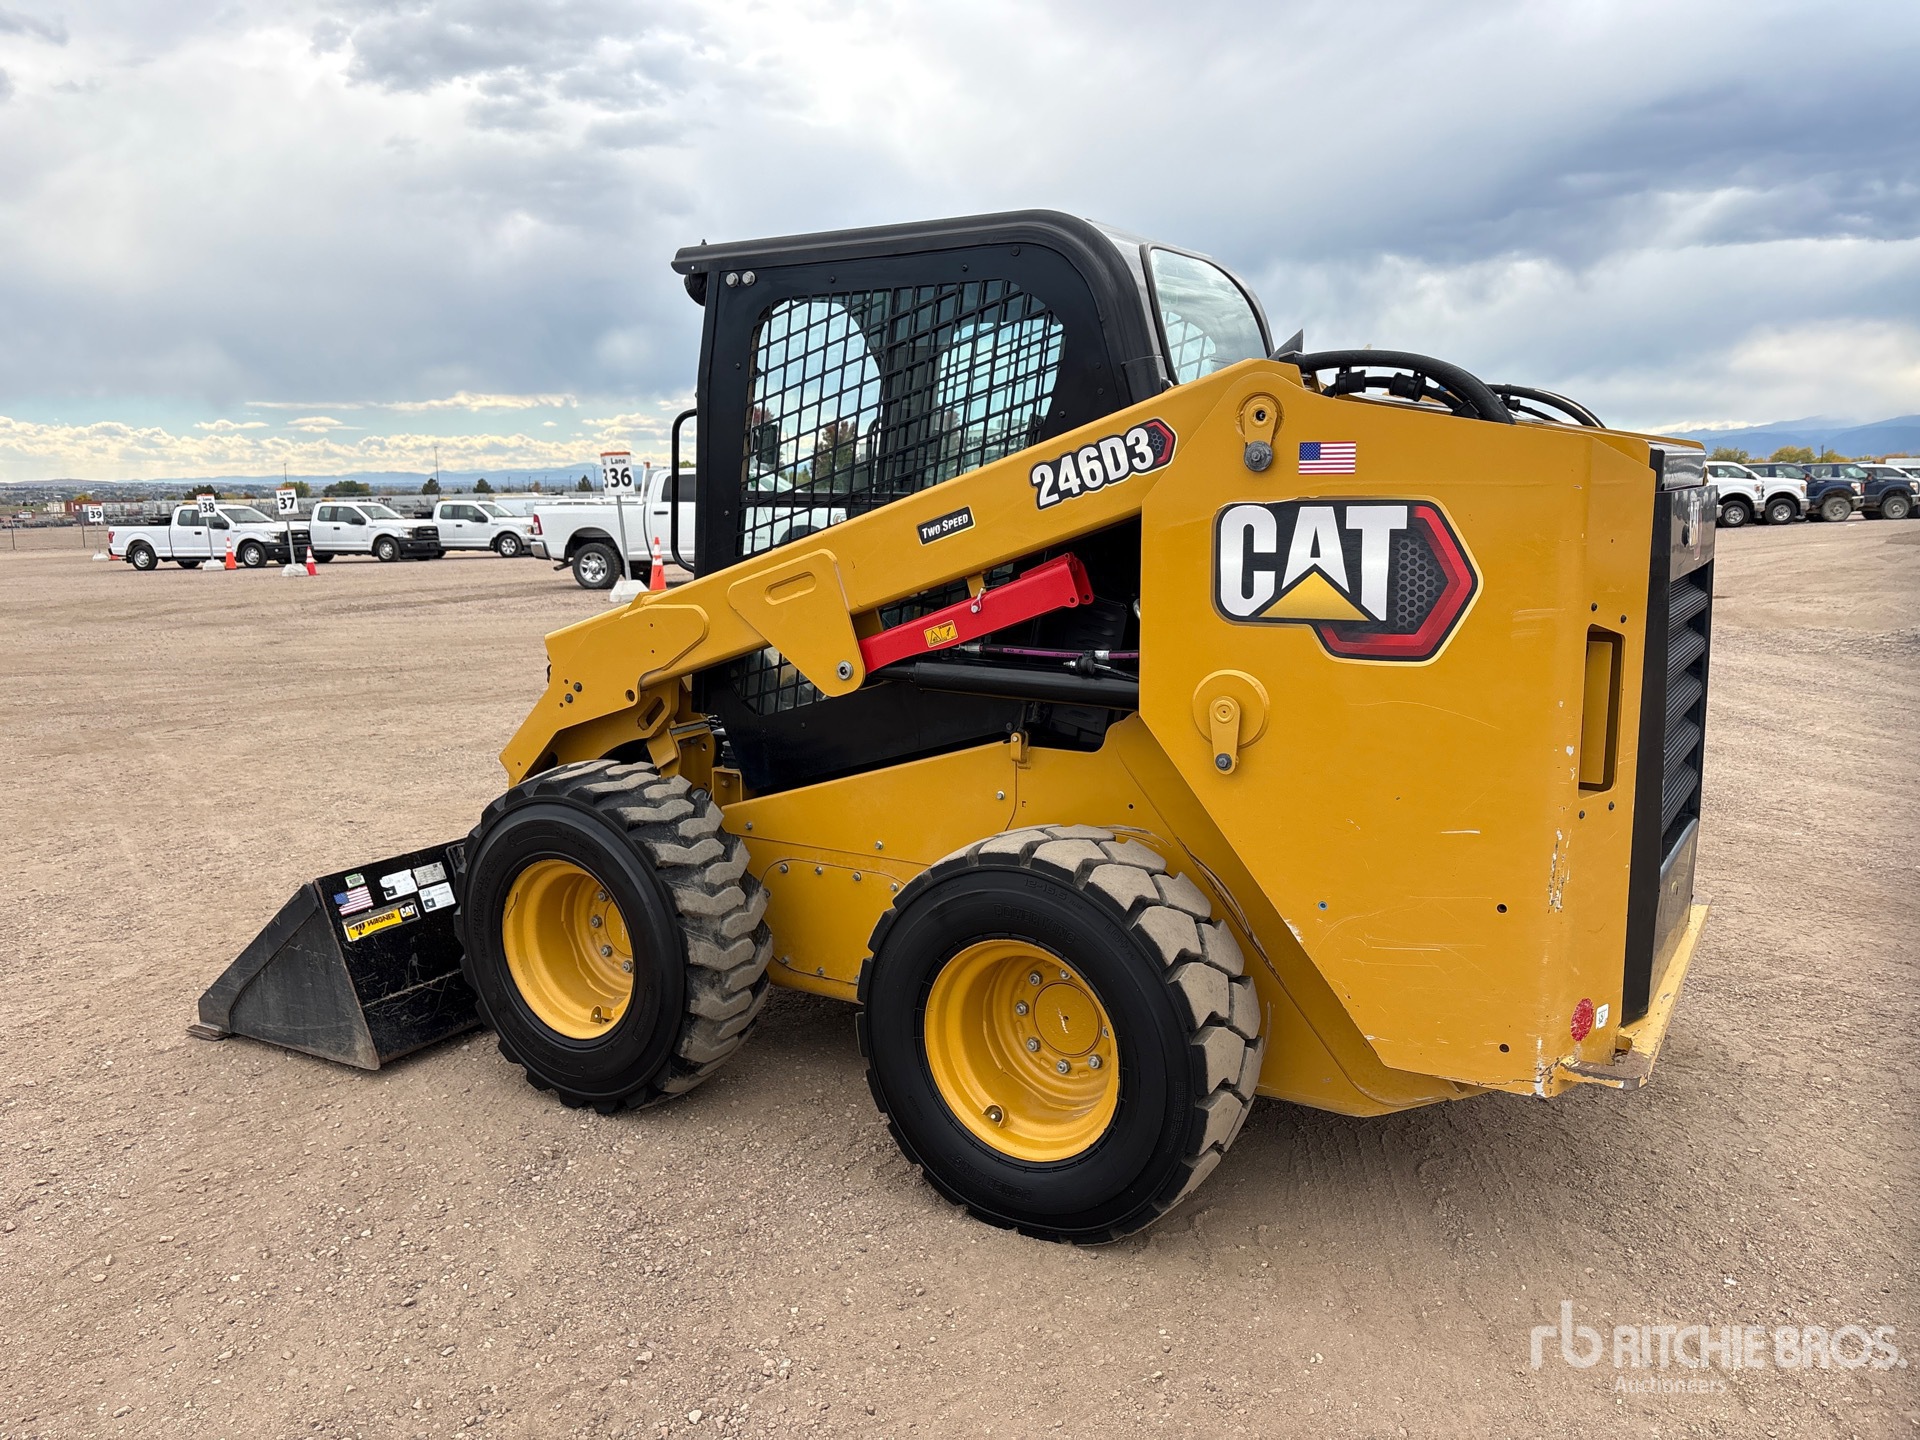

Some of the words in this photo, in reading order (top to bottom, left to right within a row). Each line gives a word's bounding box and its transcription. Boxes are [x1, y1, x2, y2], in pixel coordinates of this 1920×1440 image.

[1031, 427, 1154, 505] 246D3
[609, 466, 632, 488] 36
[202, 502, 215, 513] 38
[279, 497, 295, 510] 37
[90, 510, 102, 519] 39
[922, 524, 941, 539] TWO
[942, 514, 969, 531] SPEED
[1220, 505, 1408, 622] CAT
[367, 912, 396, 927] WAGNER
[400, 904, 415, 918] CAT
[992, 903, 1040, 928] POWER
[1042, 913, 1076, 944] KING
